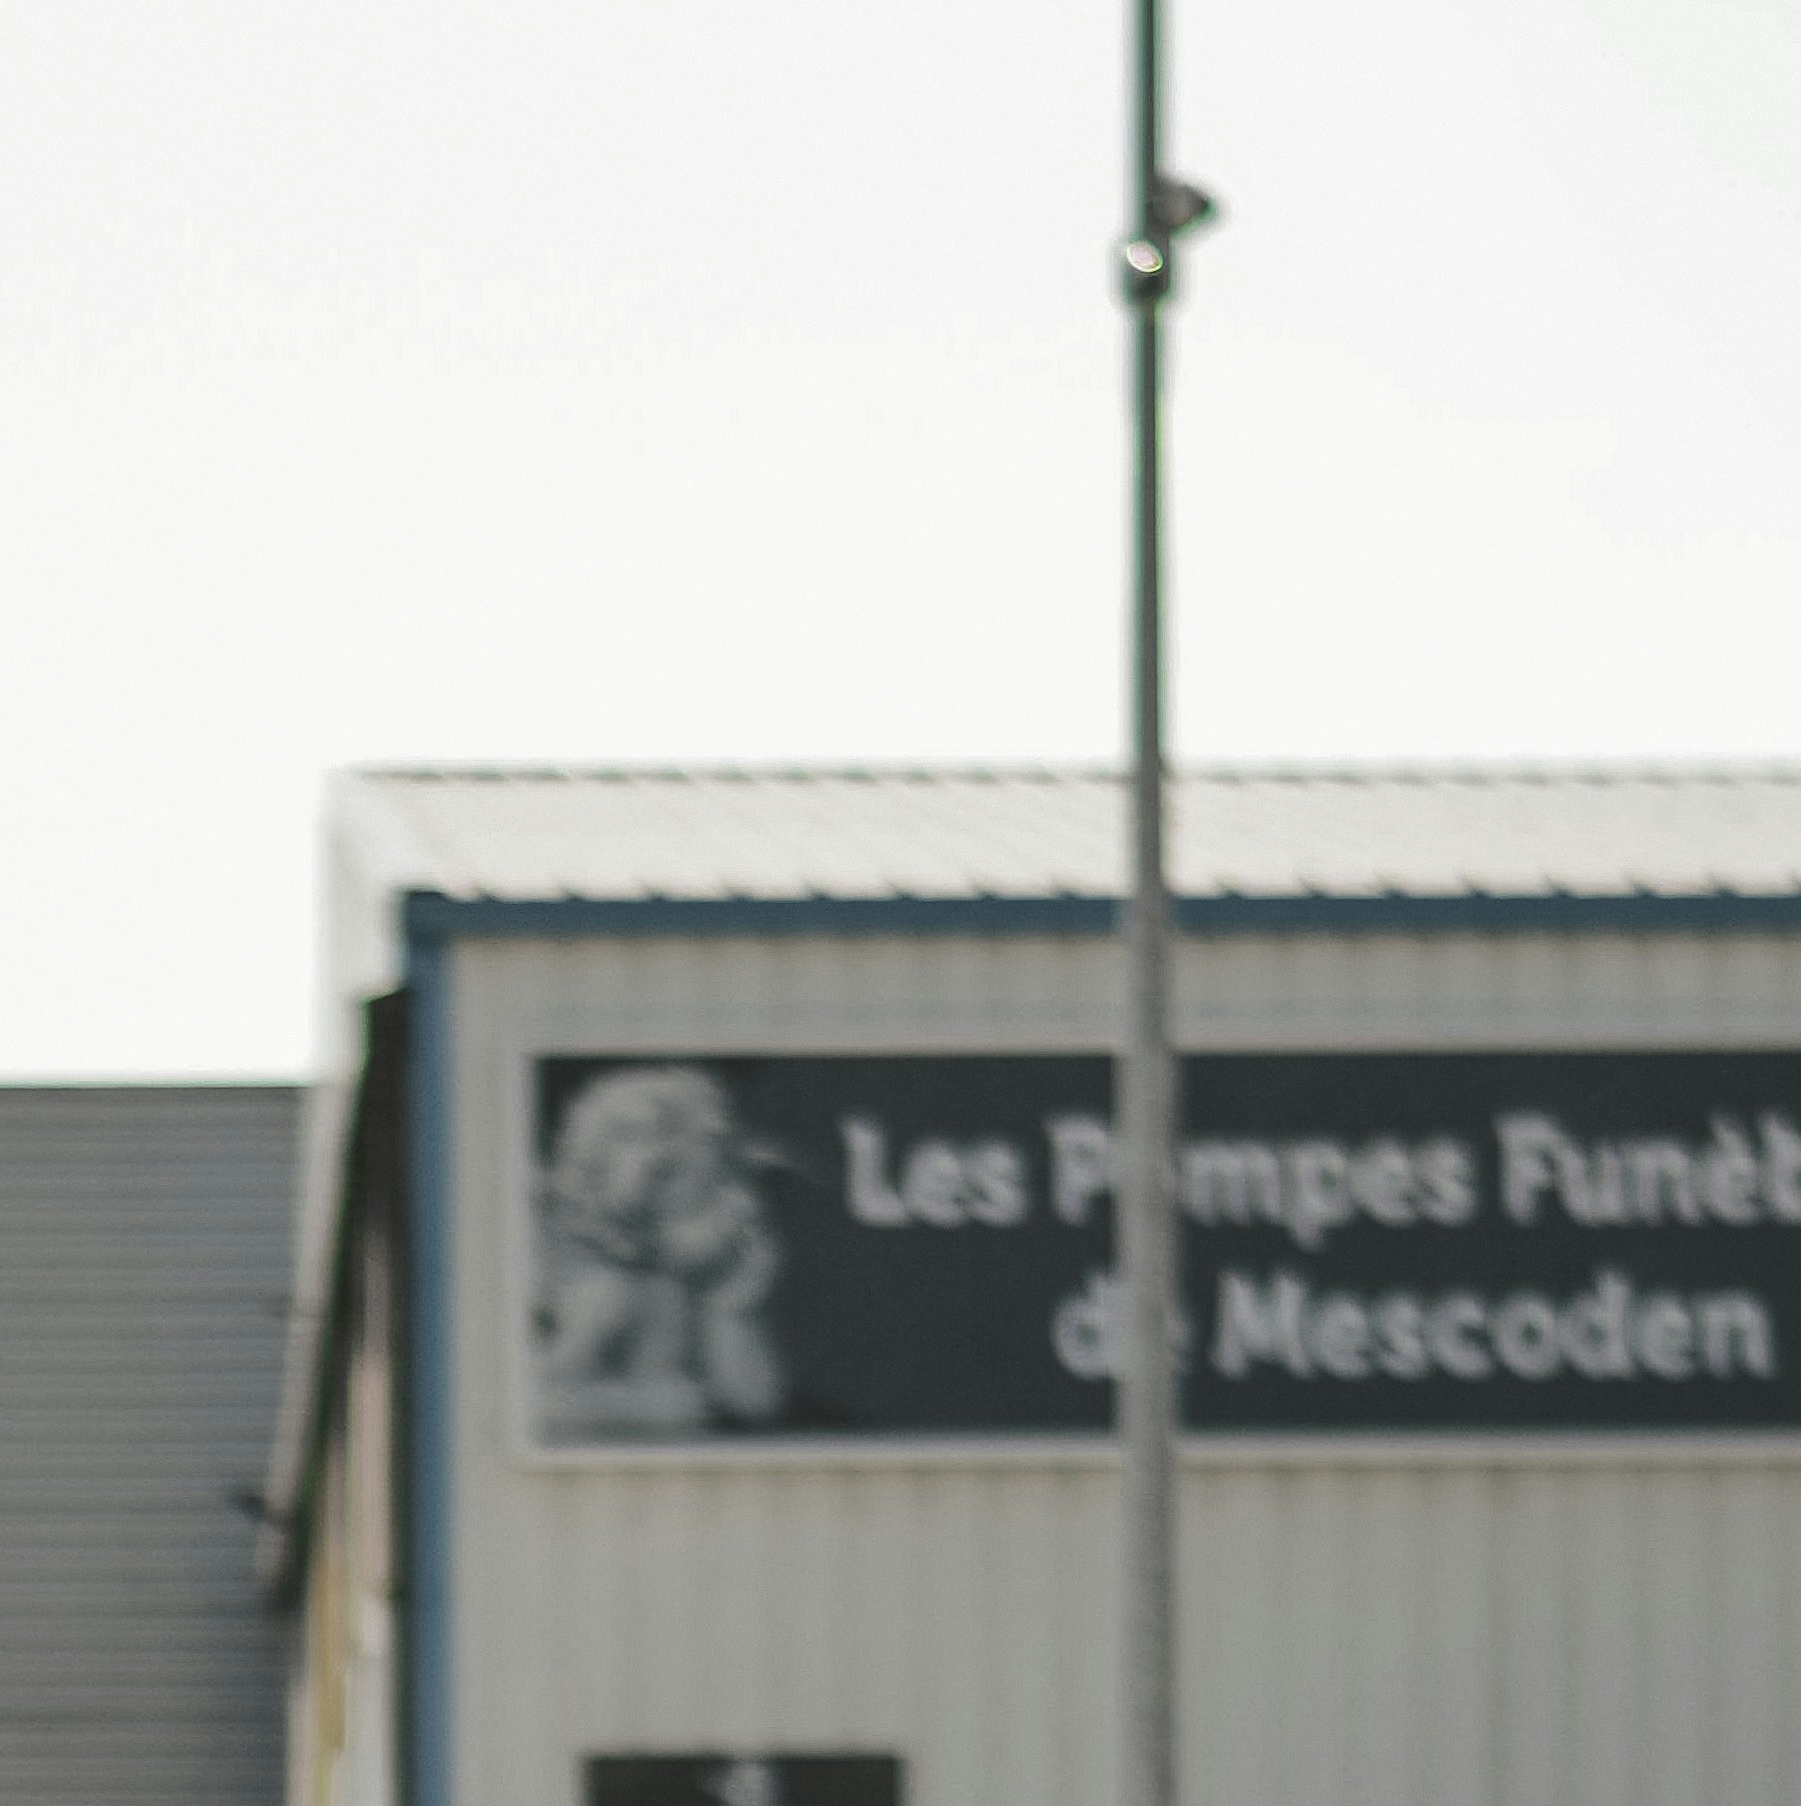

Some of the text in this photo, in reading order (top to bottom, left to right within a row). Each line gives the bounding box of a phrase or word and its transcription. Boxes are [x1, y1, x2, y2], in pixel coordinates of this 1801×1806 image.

[840, 1112, 1029, 1230] Les
[1044, 1112, 1474, 1253] Pmpes
[1049, 1268, 1774, 1382] d Mescoden
